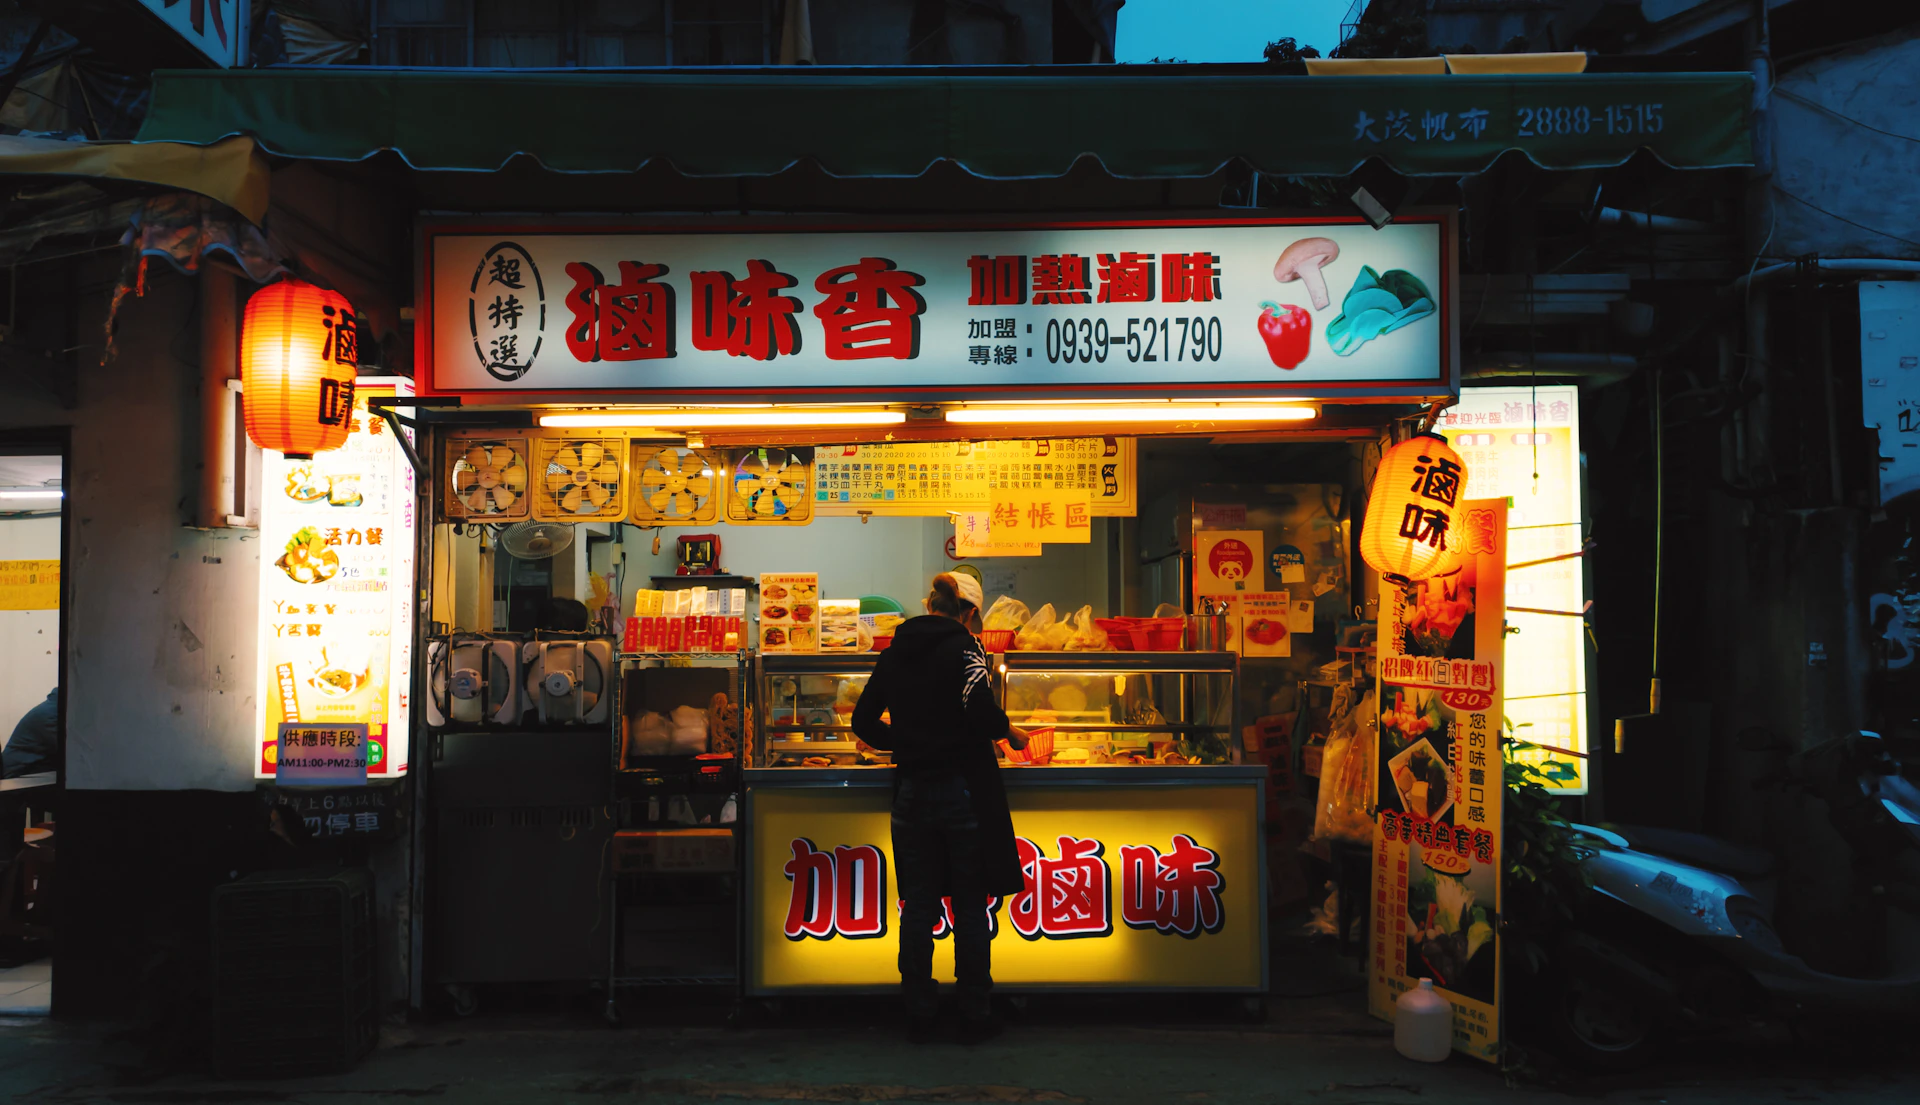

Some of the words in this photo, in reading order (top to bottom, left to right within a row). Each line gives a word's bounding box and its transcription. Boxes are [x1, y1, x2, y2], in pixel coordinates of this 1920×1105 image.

[1517, 103, 1664, 137] 2888-1515
[967, 251, 1222, 306] 加熱滷味
[487, 254, 526, 369] 超特選
[565, 256, 927, 363] 滷味香
[1046, 316, 1222, 365] 0939-521790
[993, 502, 1089, 529] 結帳區
[1399, 455, 1460, 552] 滷味
[324, 528, 384, 546] 活力餐
[1384, 656, 1490, 687] 招牌紅白對饗
[1444, 691, 1490, 707] 130元
[283, 729, 362, 748] 供應時段:
[277, 757, 366, 768] AM11:00-PM2:30
[784, 834, 1226, 941] 加滷味
